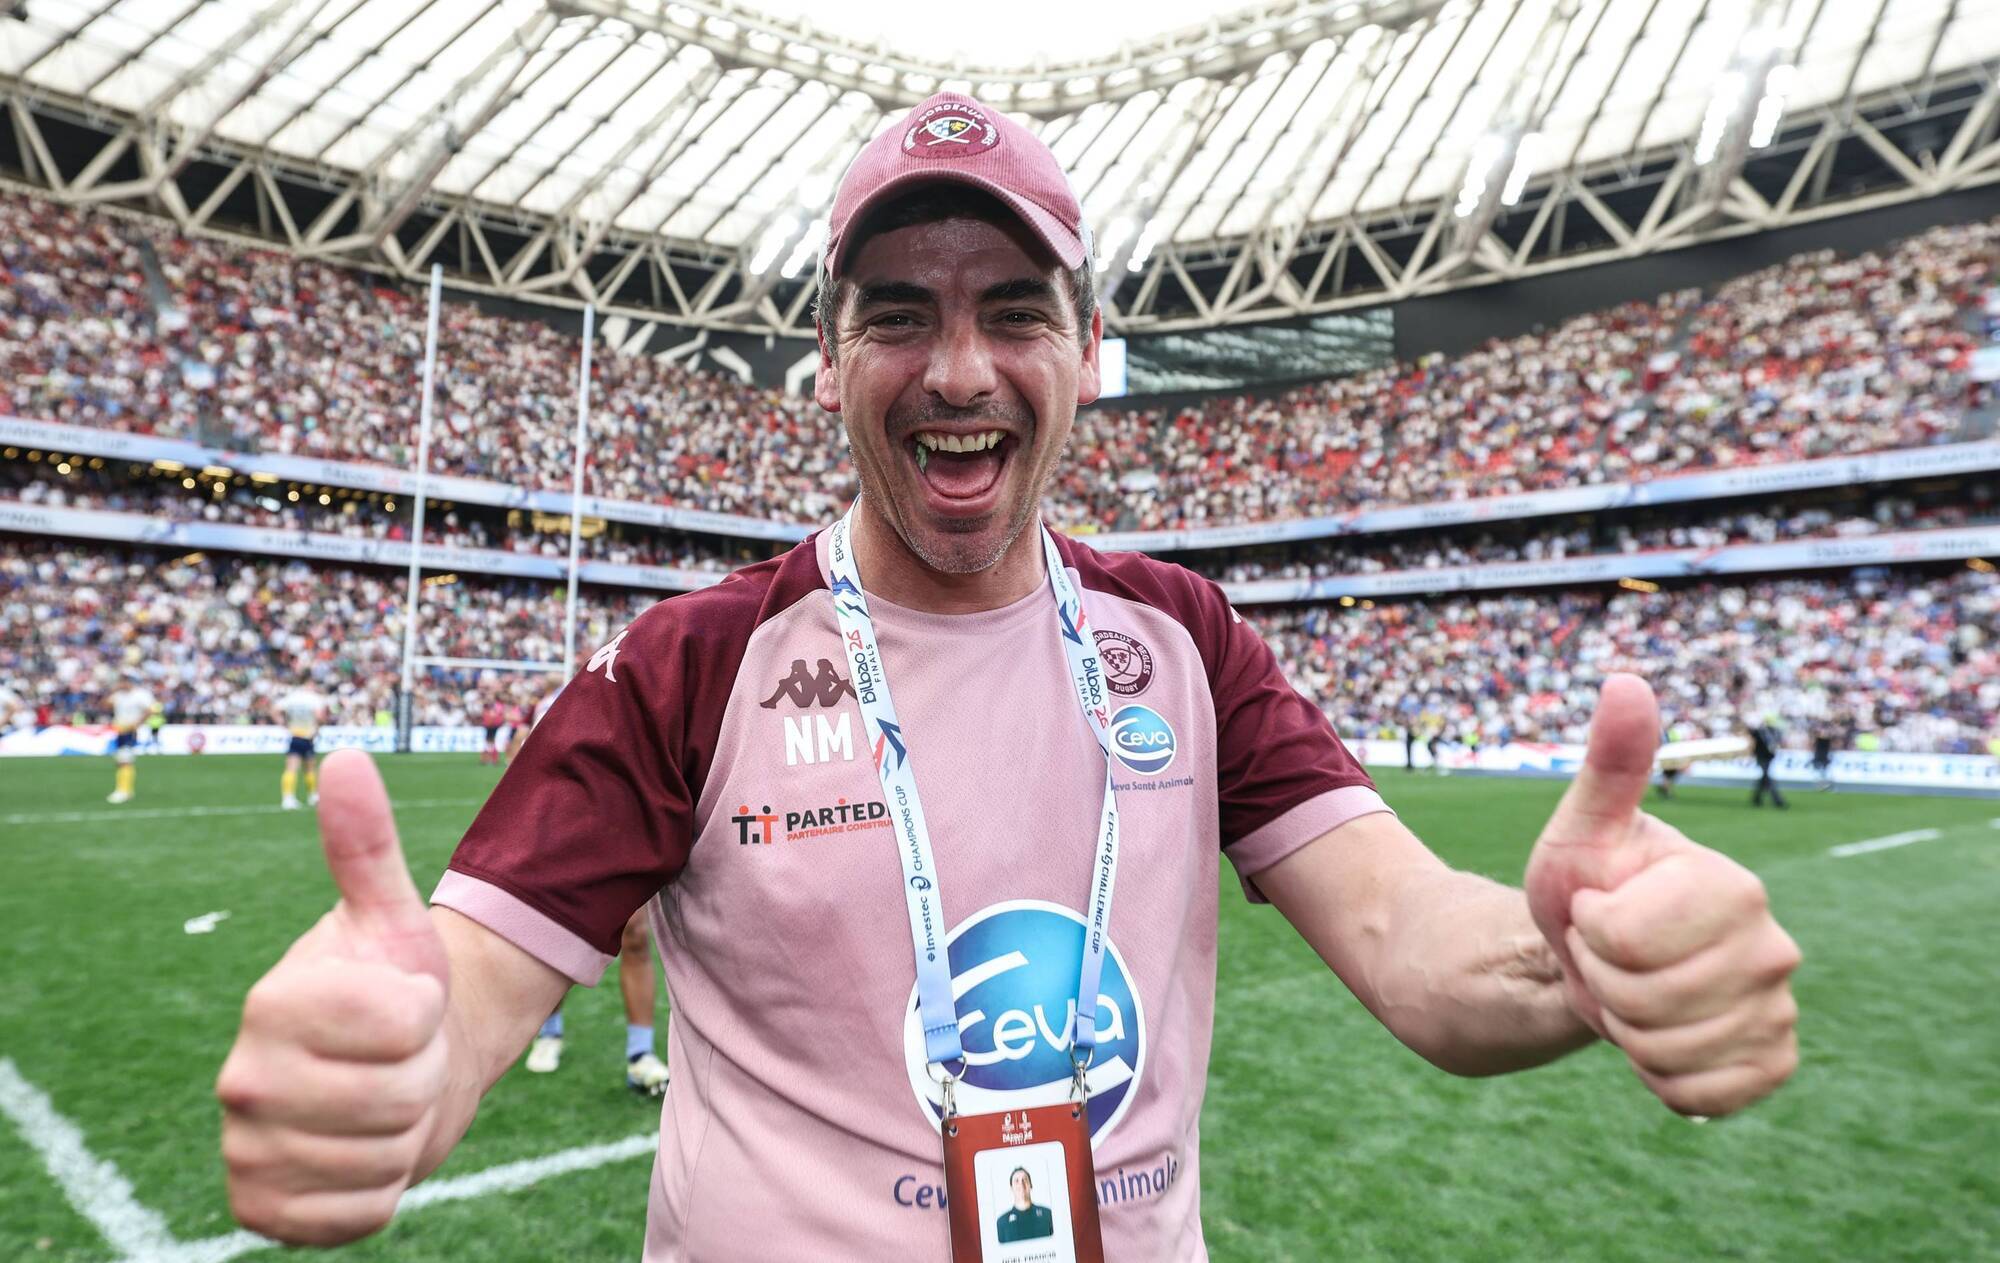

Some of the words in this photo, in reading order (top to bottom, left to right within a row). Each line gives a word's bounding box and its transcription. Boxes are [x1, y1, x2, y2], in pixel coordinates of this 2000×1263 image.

[1093, 632, 1133, 644] ORDEAUX
[854, 652, 877, 705] Bilbao
[865, 643, 881, 684] FINALS
[1137, 645, 1151, 675] BEGLES
[1077, 676, 1093, 717] FINALS
[1082, 657, 1102, 706] Bilbao
[1114, 683, 1139, 693] RUGBY
[783, 712, 854, 766] NM
[895, 785, 908, 806] CUP
[1111, 781, 1131, 791] eva
[786, 798, 892, 832] PARTED
[787, 826, 845, 842] PARTENAIRE
[847, 819, 893, 832] CONSTRU
[1105, 811, 1115, 853] EPCR
[901, 807, 923, 871] CHAMPIONS
[1094, 866, 1110, 930] CHALLENGE
[919, 895, 936, 952] Investec
[1091, 932, 1101, 954] CUP
[894, 1175, 948, 1209] Cev
[1096, 1155, 1178, 1205] nimale
